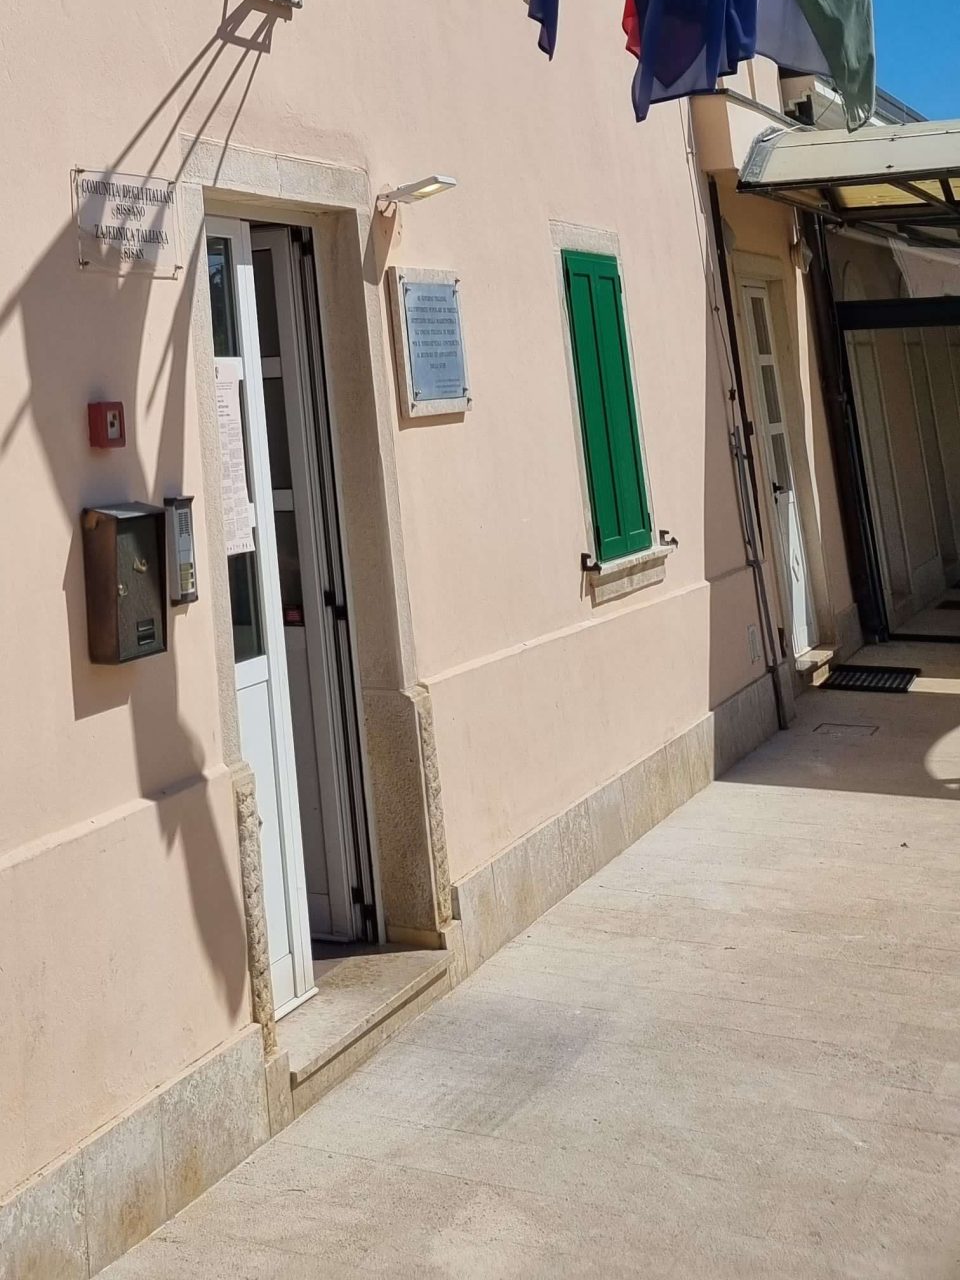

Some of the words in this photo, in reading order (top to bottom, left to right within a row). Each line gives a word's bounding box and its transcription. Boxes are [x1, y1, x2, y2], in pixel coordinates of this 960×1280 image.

[122, 184, 144, 201] DEGLI
[145, 187, 175, 204] ITALIANI
[116, 203, 146, 217] SISSANO
[94, 224, 135, 241] ZAJEDNICA
